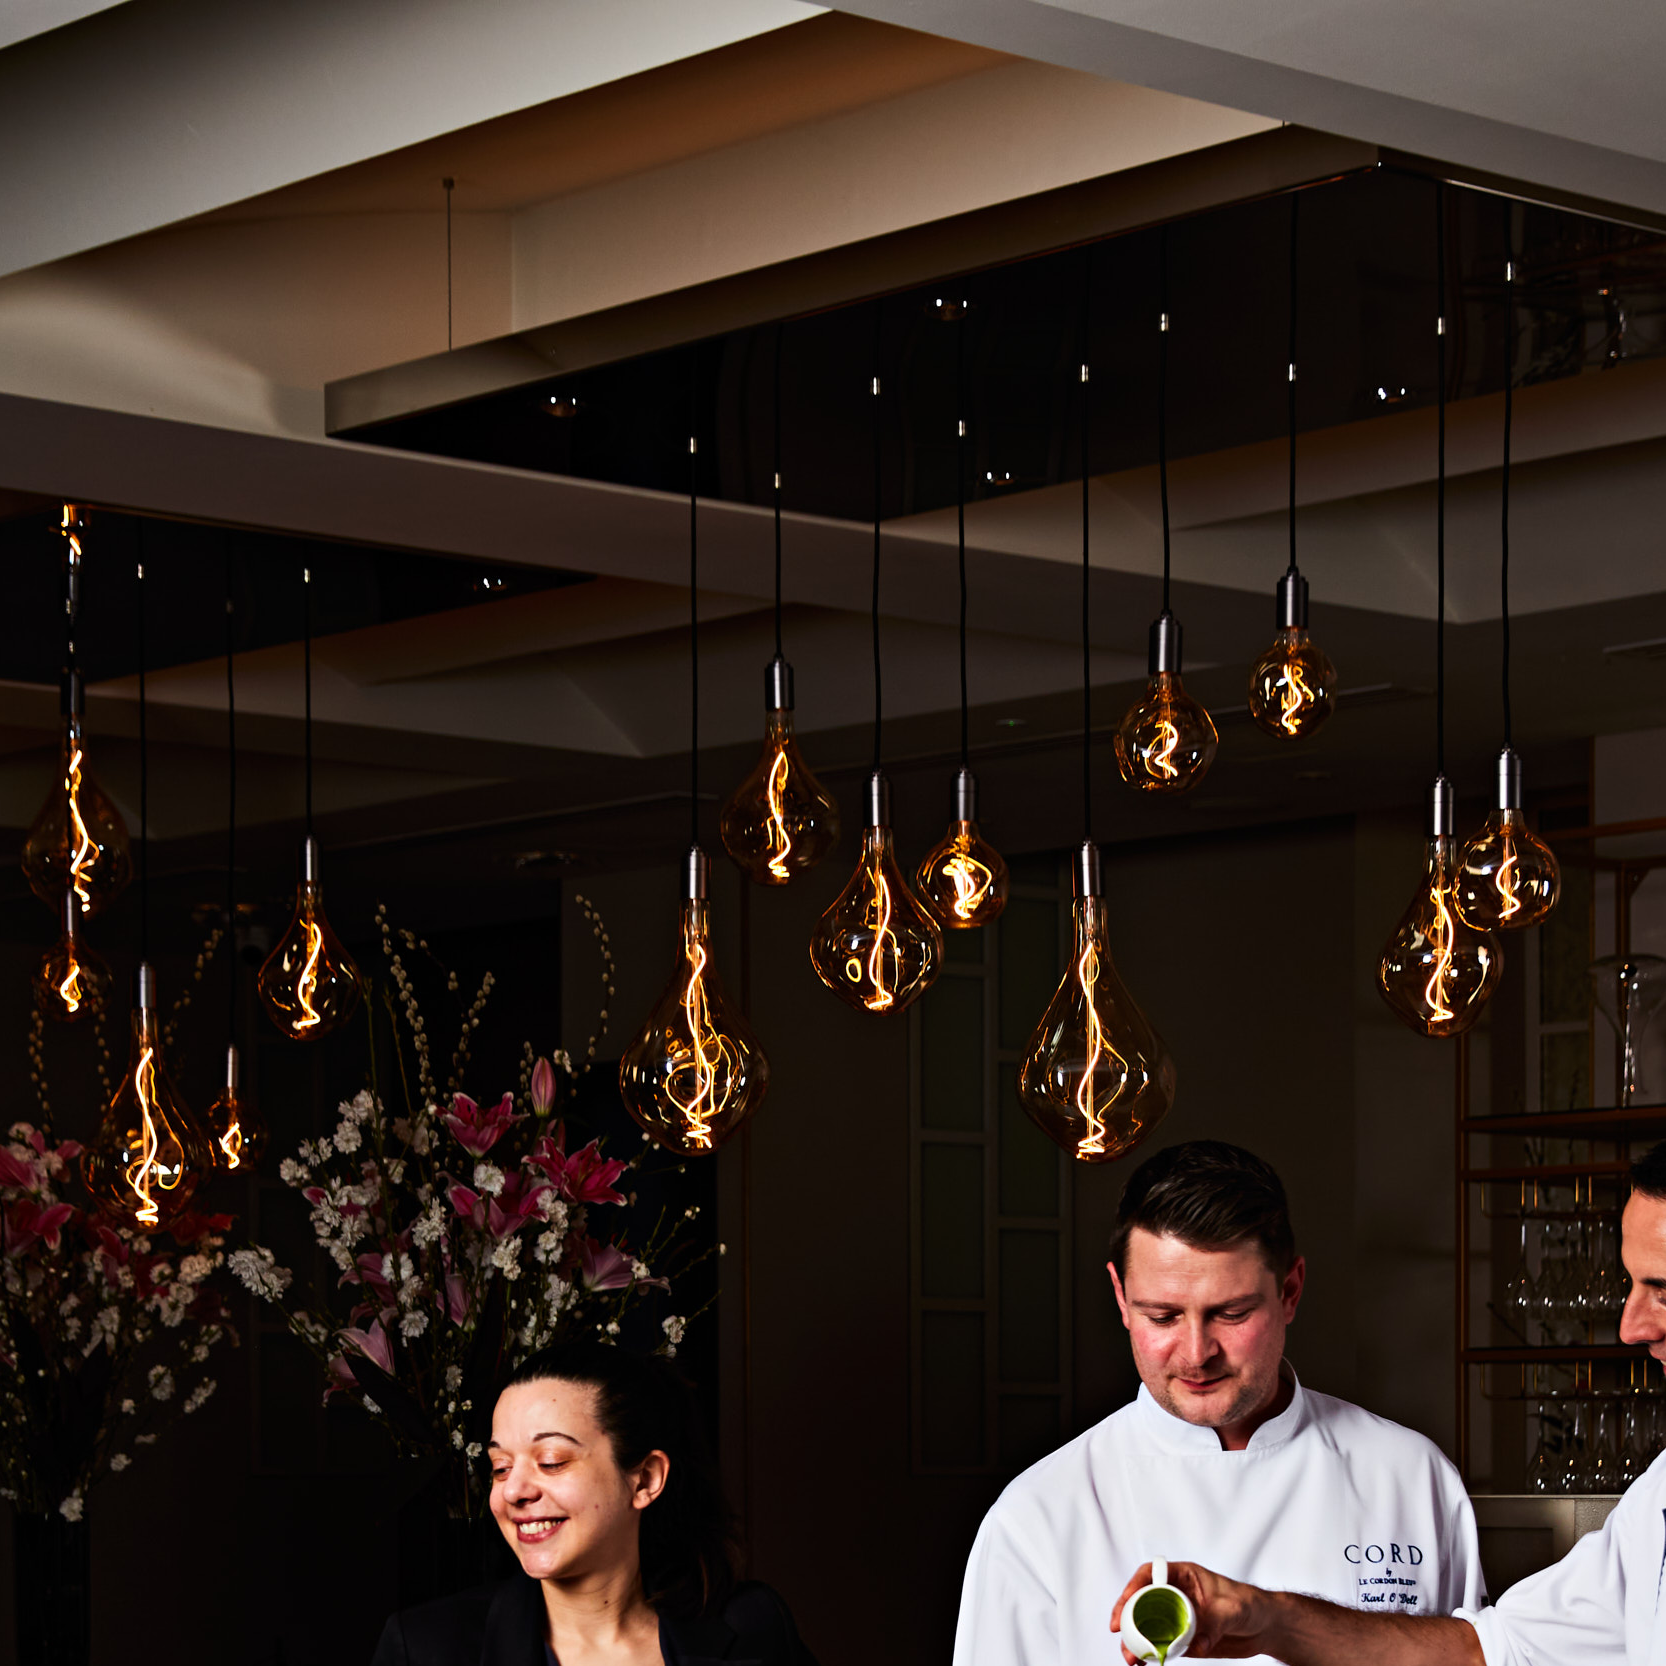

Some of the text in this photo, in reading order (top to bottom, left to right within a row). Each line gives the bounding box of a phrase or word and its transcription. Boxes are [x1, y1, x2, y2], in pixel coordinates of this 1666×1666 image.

[1344, 1543, 1423, 1565] CORD
[1386, 1568, 1392, 1577] by
[1358, 1578, 1368, 1586] LE
[1361, 1592, 1385, 1603] Karl
